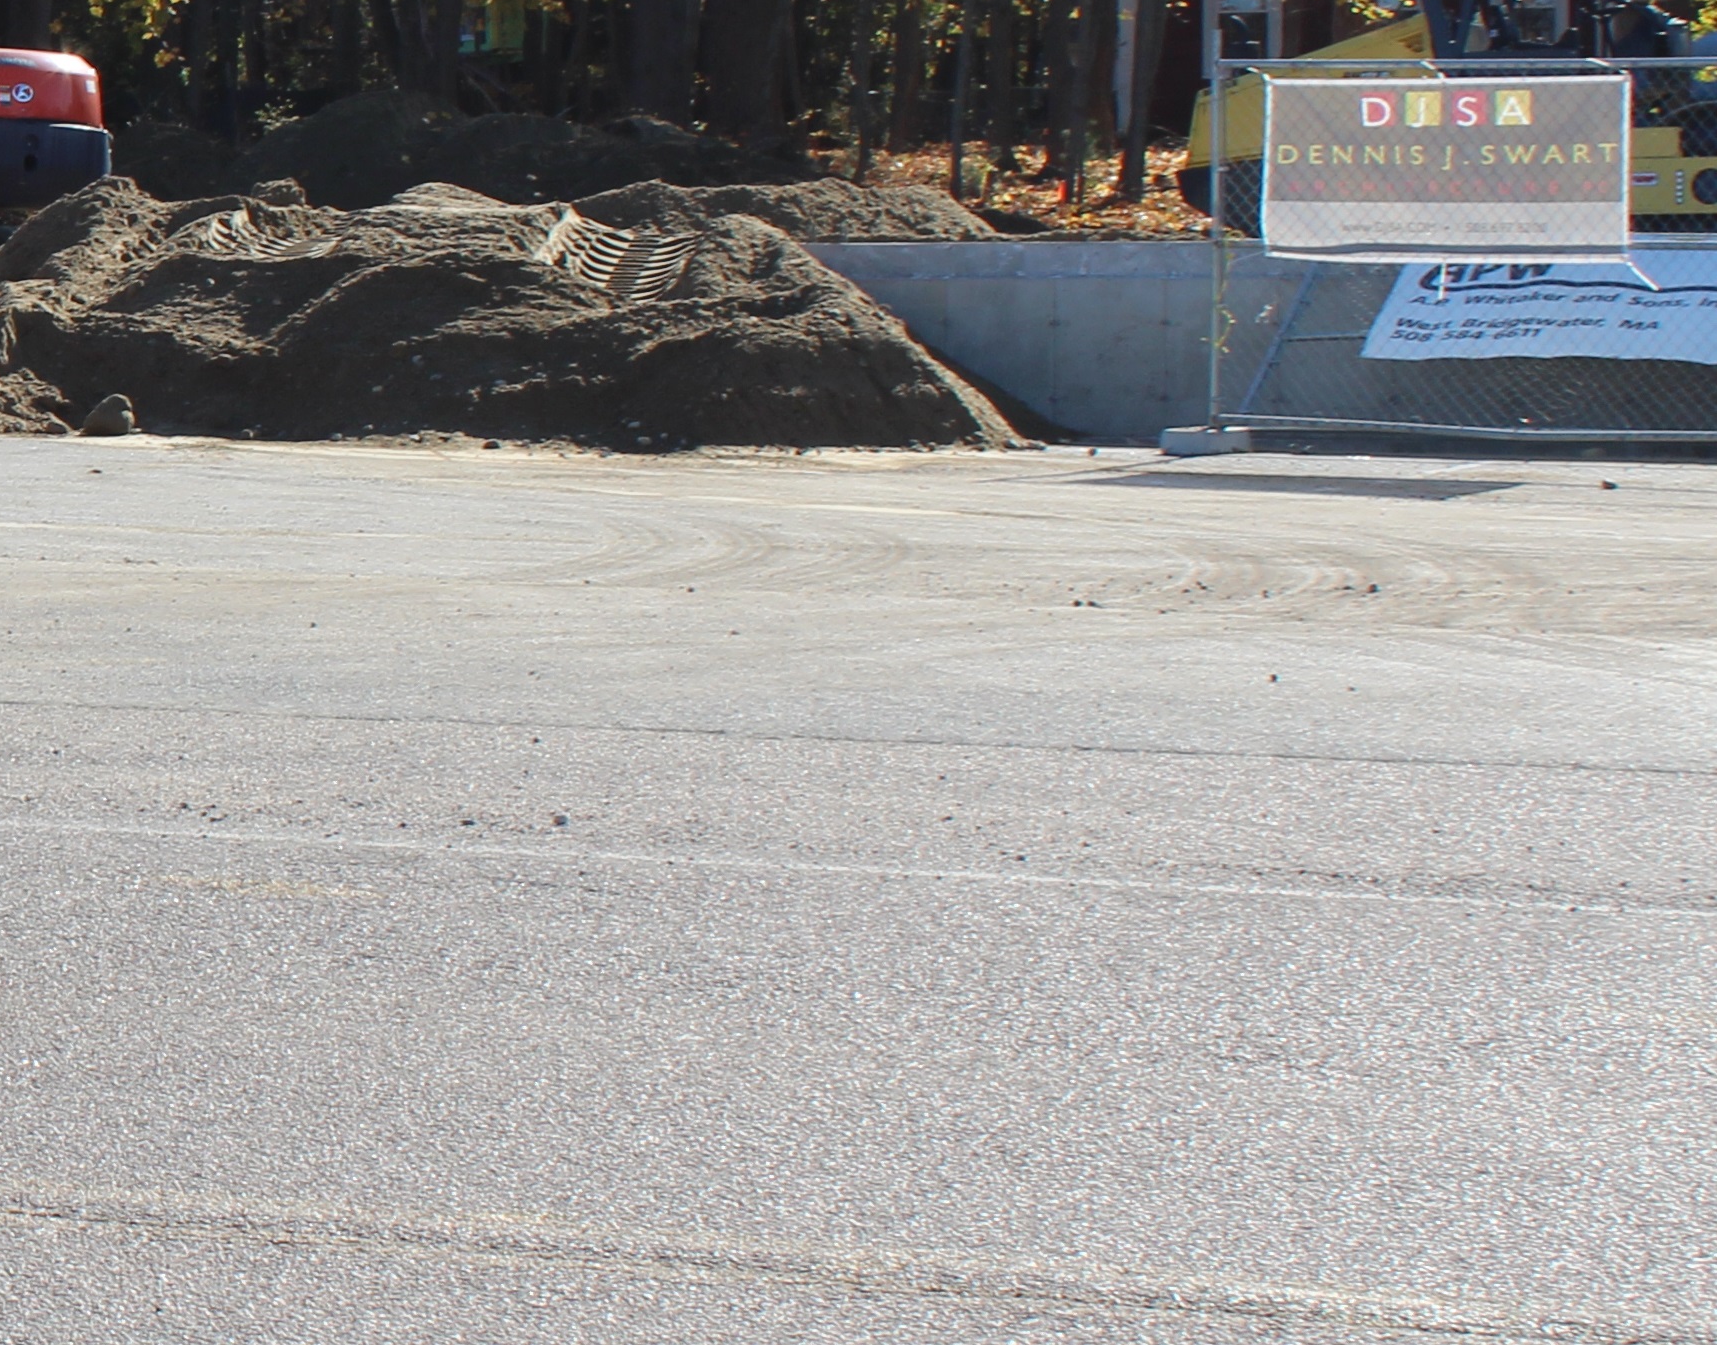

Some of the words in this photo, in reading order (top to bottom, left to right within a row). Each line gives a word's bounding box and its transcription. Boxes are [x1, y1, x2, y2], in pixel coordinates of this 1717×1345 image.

[1276, 143, 1425, 166] DENNIS
[1480, 143, 1619, 166] SWART
[1464, 291, 1567, 305] Whitaker
[1572, 293, 1621, 303] and
[1396, 317, 1453, 331] West
[1617, 319, 1660, 331] MA
[1389, 329, 1435, 343] 508
